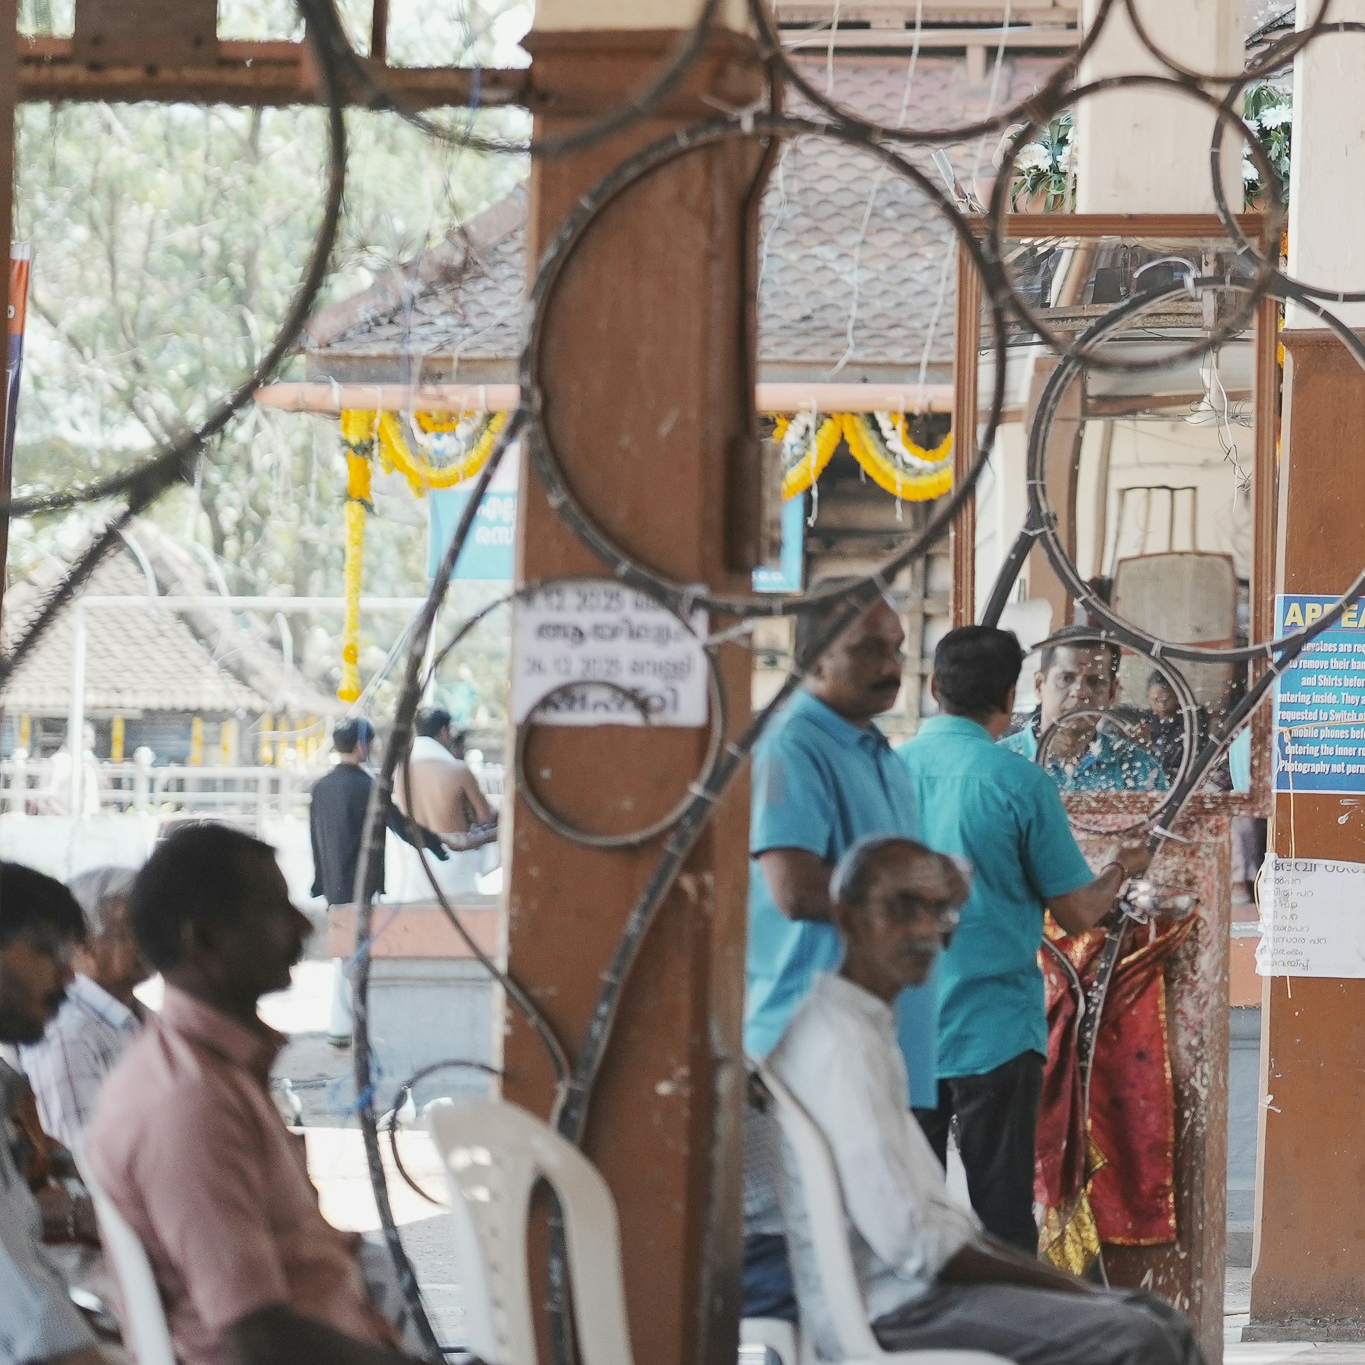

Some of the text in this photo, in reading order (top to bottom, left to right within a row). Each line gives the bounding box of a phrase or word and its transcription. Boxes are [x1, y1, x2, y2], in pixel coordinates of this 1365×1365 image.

[1339, 644, 1352, 653] are
[1299, 659, 1330, 669] remove
[1330, 658, 1351, 670] their
[1301, 675, 1317, 686] and
[1317, 675, 1343, 687] Shirts
[1278, 691, 1311, 706] entering
[1312, 692, 1339, 705] inside.
[1341, 693, 1361, 706] They
[1278, 710, 1318, 721] requested
[1319, 710, 1328, 721] to
[1329, 709, 1357, 722] Switch
[1291, 727, 1319, 738] mobile
[1320, 727, 1350, 740] phones
[1285, 744, 1320, 757] entering
[1320, 744, 1335, 756] the
[1335, 744, 1357, 756] inner
[1331, 762, 1346, 773] not
